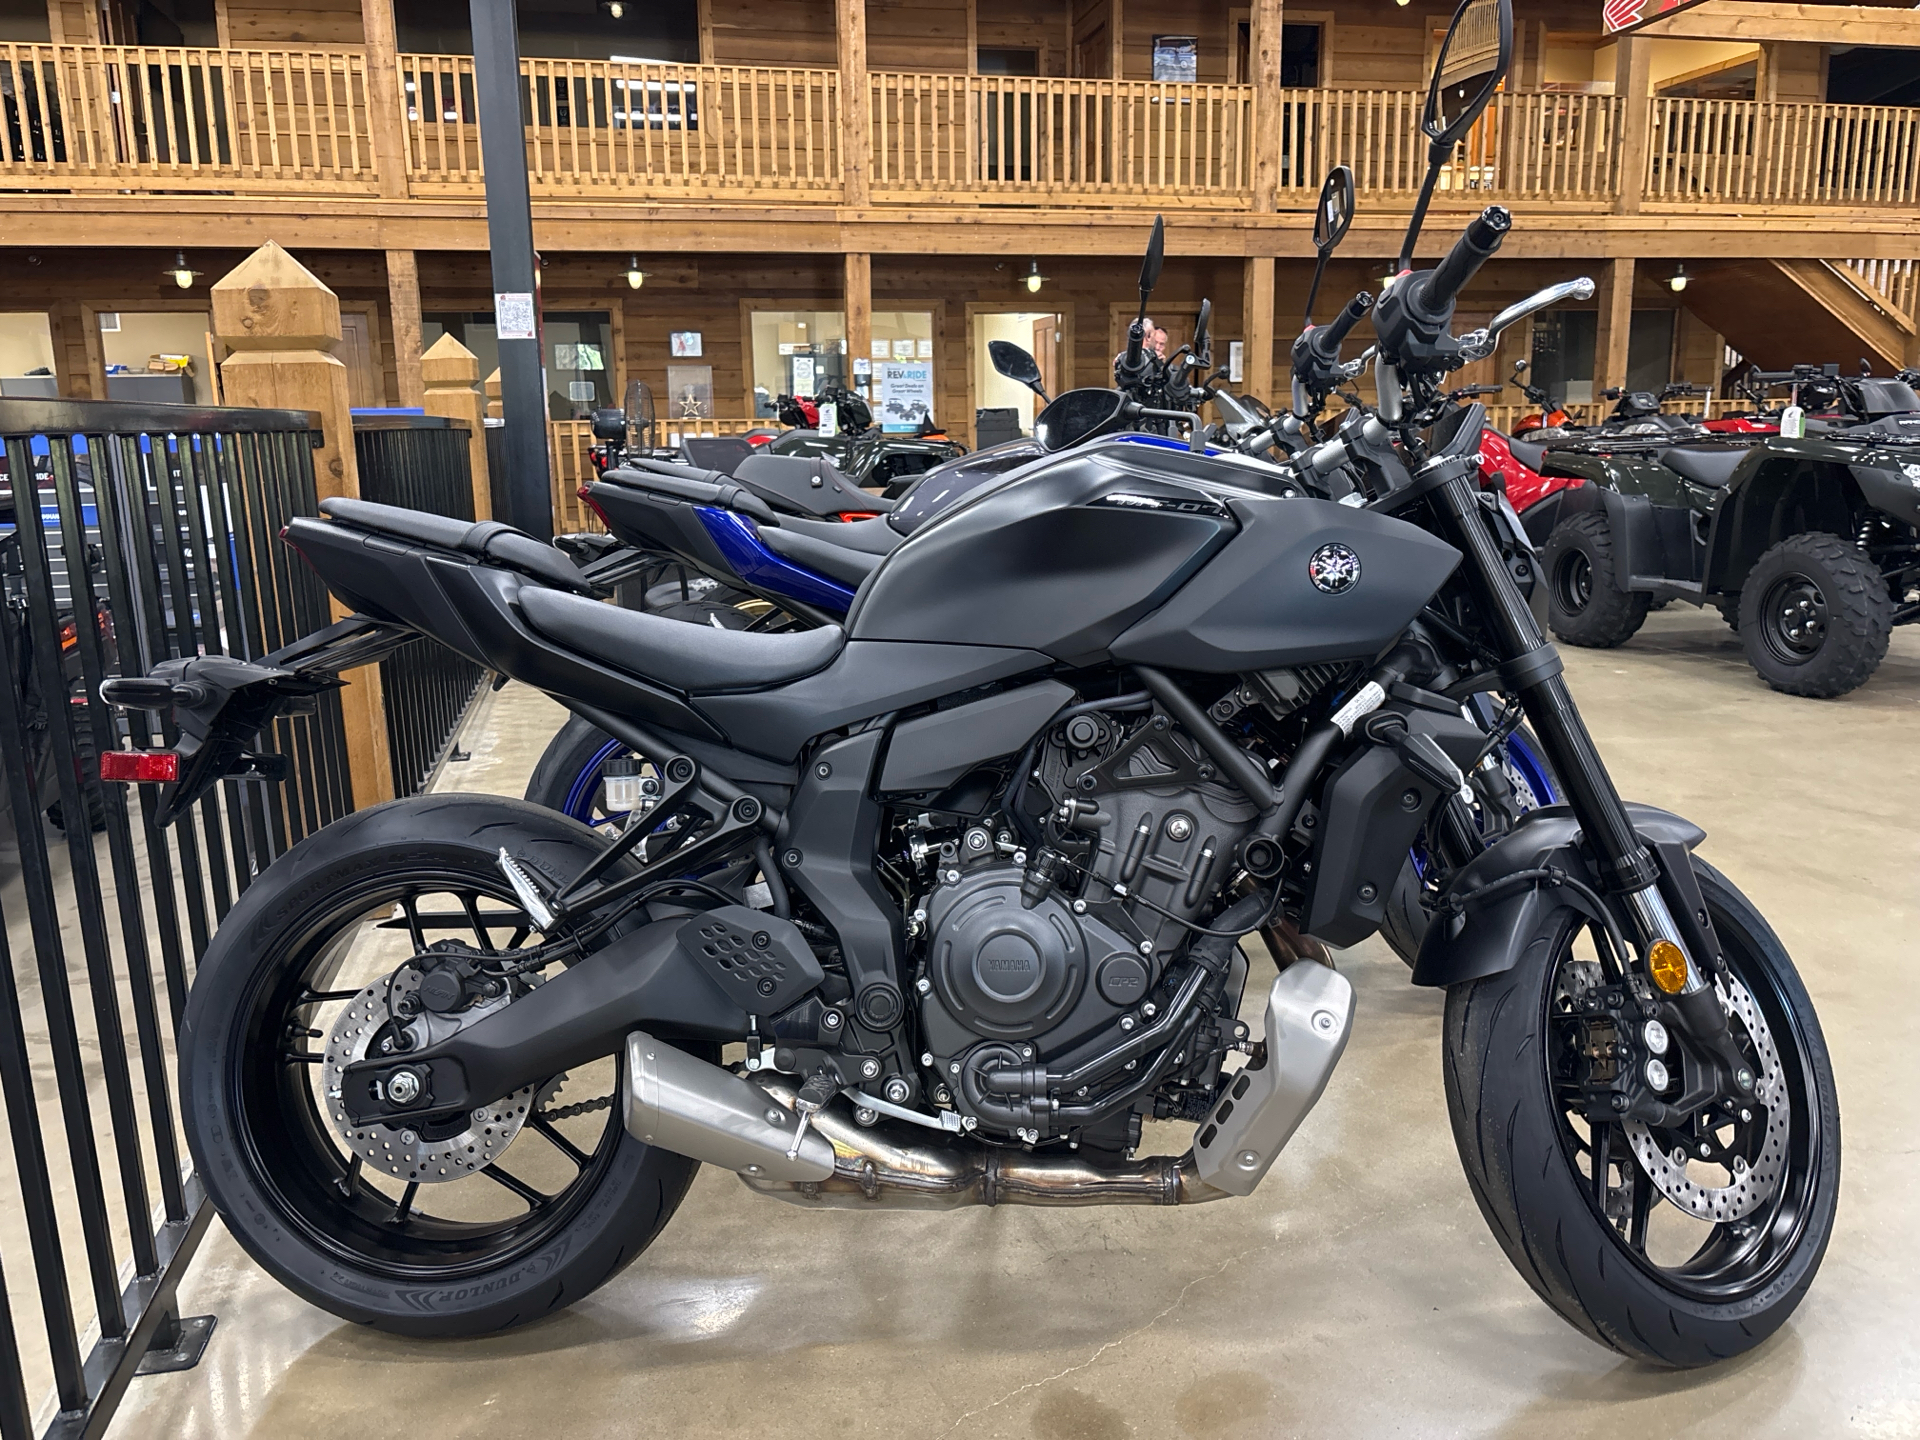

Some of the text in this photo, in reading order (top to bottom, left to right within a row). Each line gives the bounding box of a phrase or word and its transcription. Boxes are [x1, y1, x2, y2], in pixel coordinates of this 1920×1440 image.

[528, 856, 569, 884] DUNL
[988, 958, 1030, 971] YAMAHA
[1109, 976, 1139, 987] CP2
[438, 1271, 521, 1301] DUNLOP
